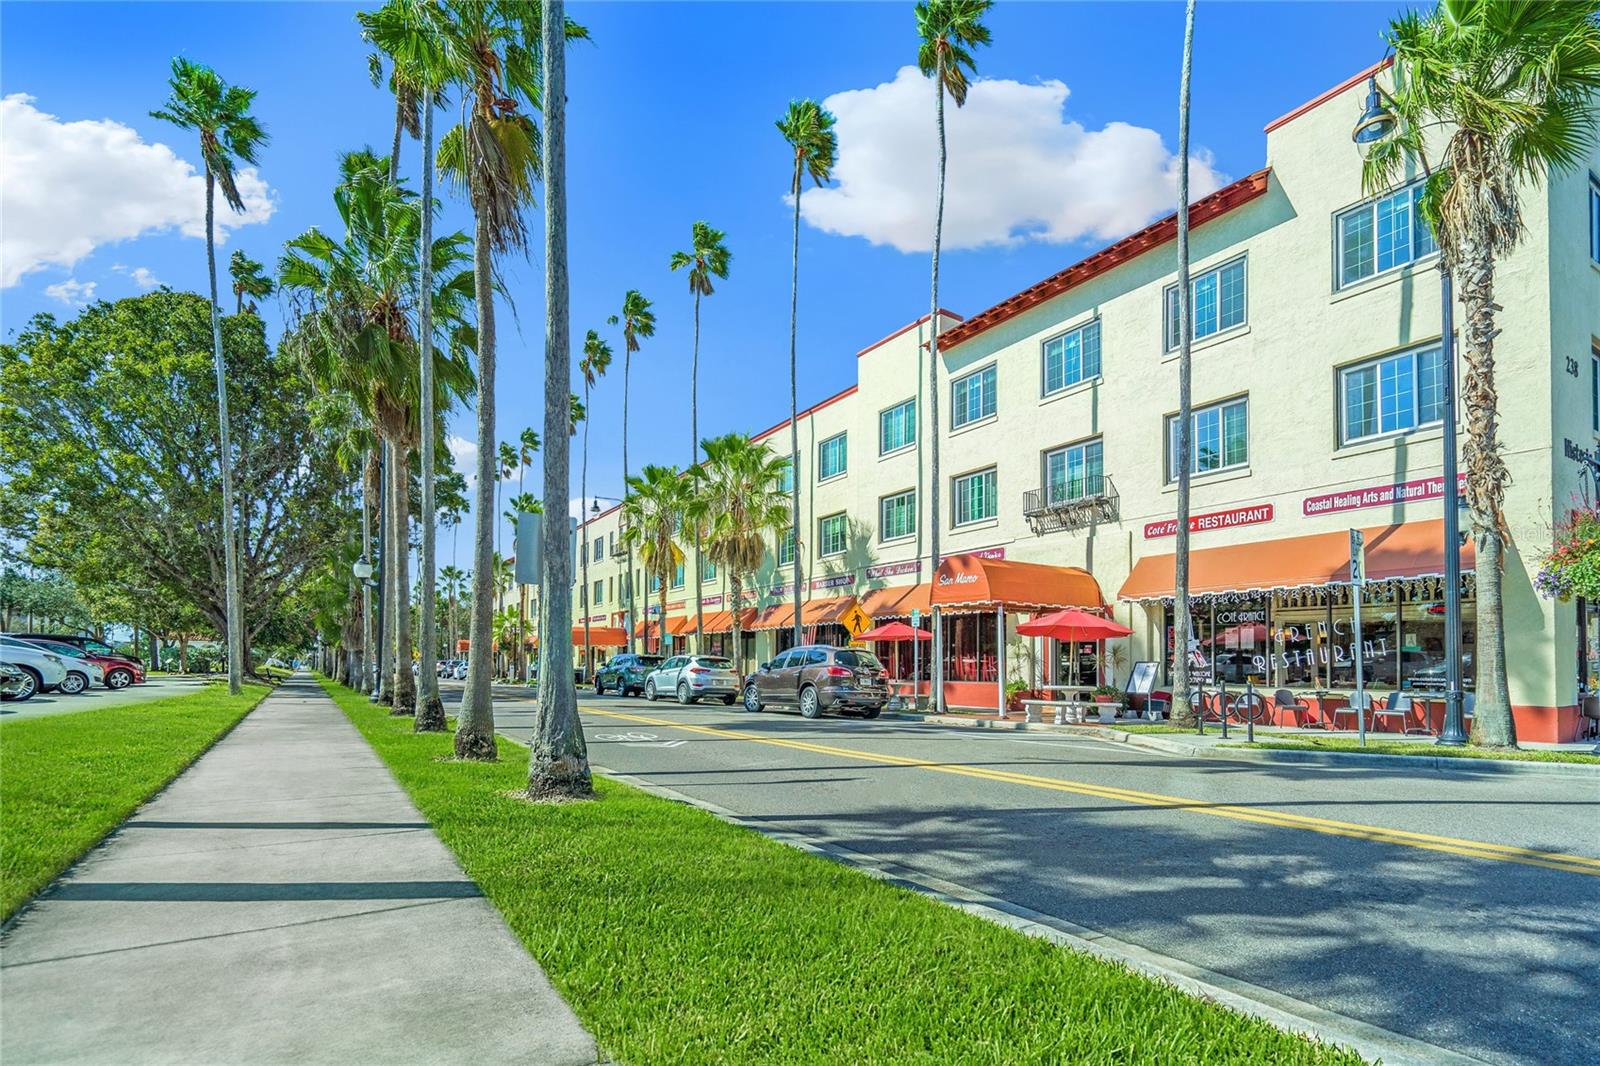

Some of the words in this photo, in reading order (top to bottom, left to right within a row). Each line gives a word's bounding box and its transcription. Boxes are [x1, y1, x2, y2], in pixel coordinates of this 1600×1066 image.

[1565, 356, 1579, 378] 238
[1306, 498, 1333, 512] Coastal
[1333, 493, 1361, 509] Healing
[1362, 491, 1378, 504] Arts
[1379, 488, 1394, 501] and
[1395, 483, 1425, 499] Natural
[1427, 478, 1467, 495] Theies
[1167, 521, 1195, 534] Fre
[1197, 508, 1269, 529] RESTAURANT
[938, 574, 954, 586] San
[1252, 637, 1387, 673] RESTAURANT
